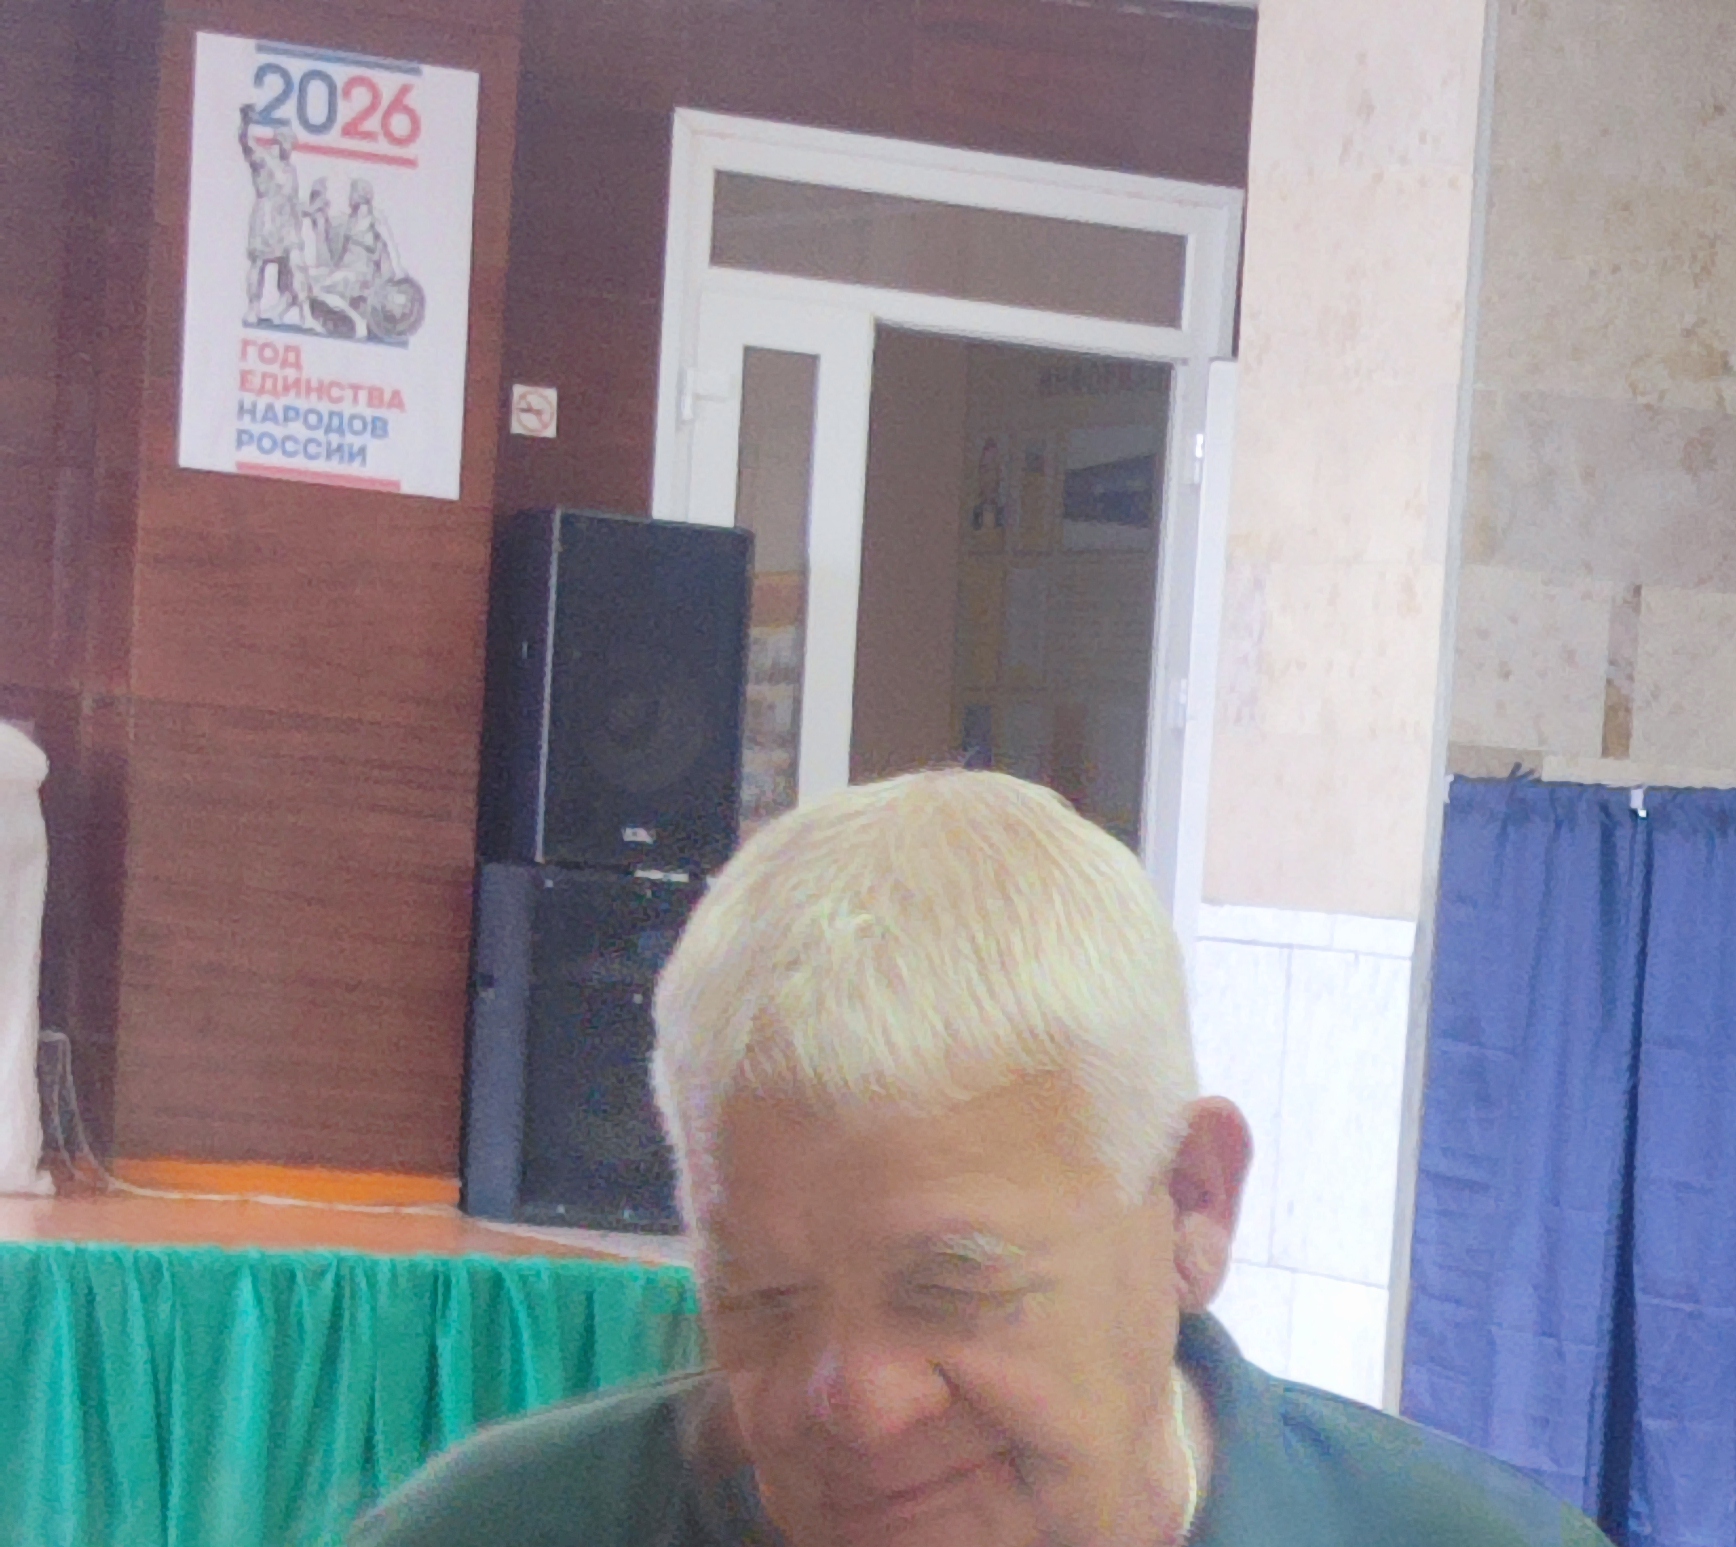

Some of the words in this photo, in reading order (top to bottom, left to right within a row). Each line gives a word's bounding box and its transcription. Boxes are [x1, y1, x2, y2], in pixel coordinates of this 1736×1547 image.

[253, 62, 422, 148] 2026
[239, 336, 303, 372] ГОД
[238, 368, 407, 413] ЕДИНСТВА
[236, 398, 389, 440] НАРОДОВ
[234, 427, 368, 468] РОССИИ
